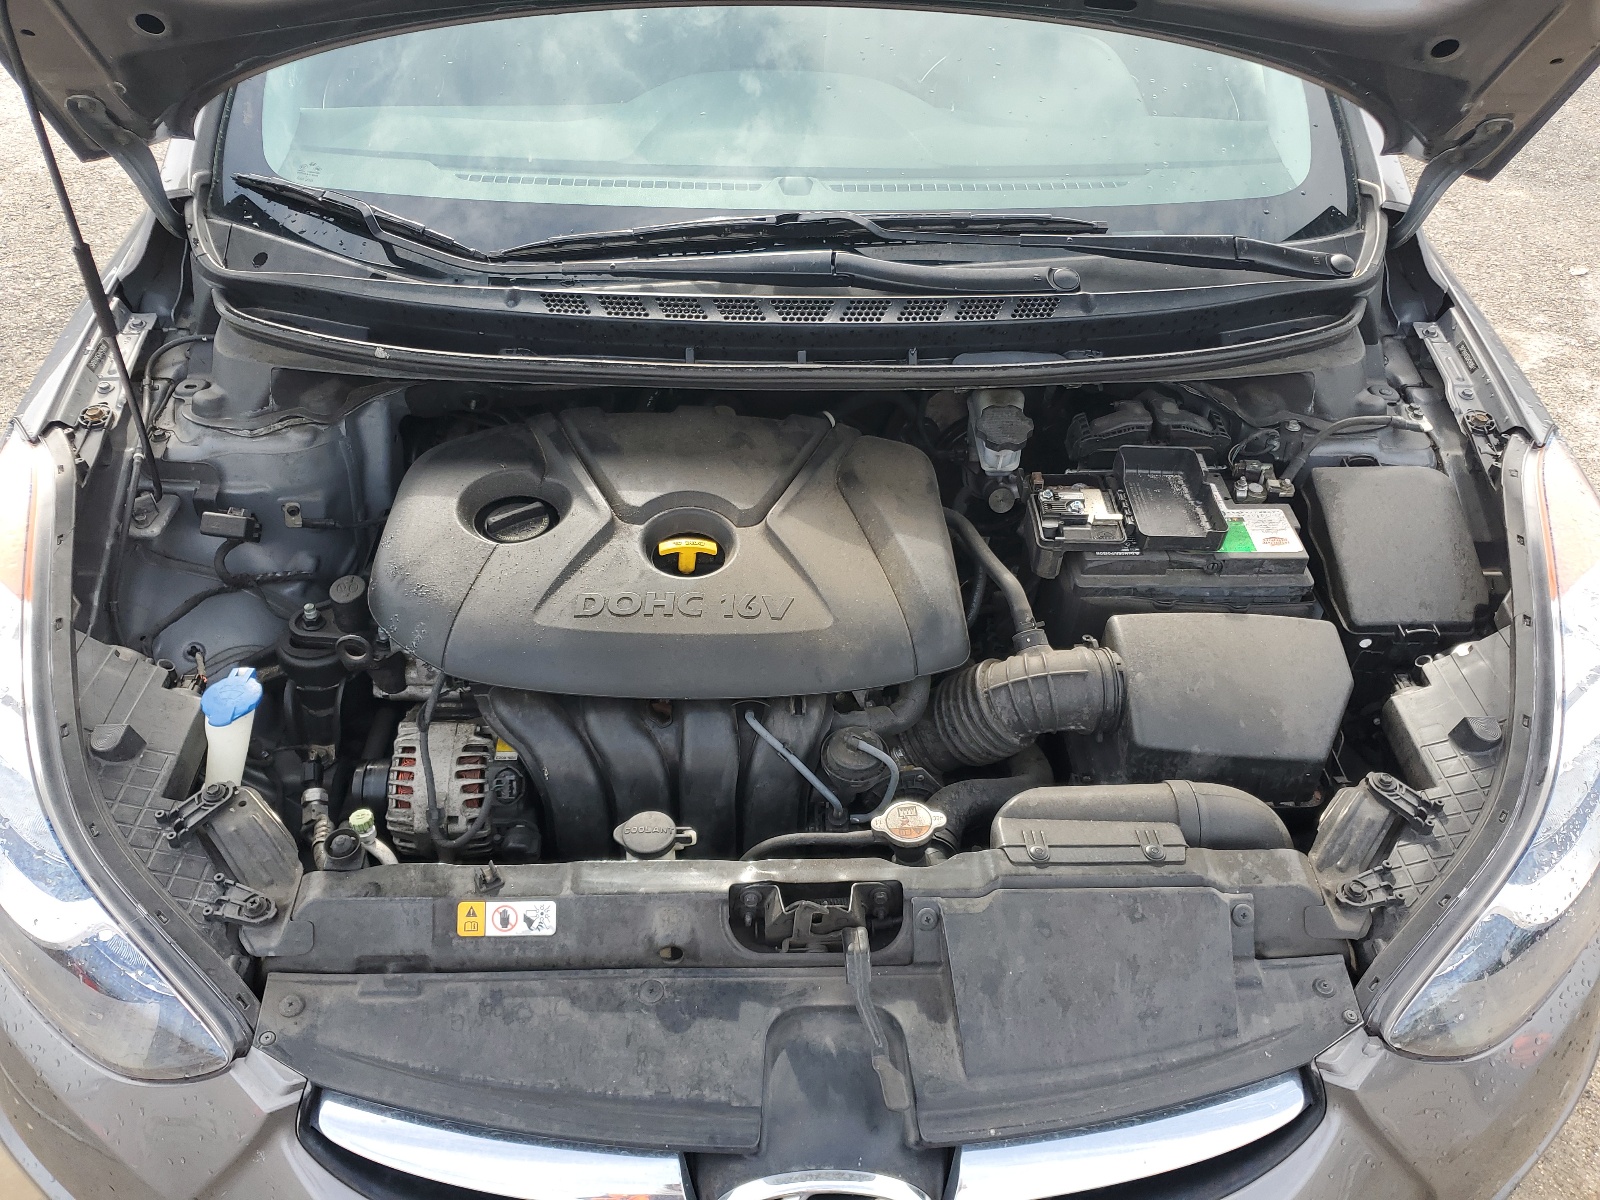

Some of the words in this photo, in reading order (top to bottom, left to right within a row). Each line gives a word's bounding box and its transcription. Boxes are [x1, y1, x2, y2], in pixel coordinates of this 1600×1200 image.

[573, 591, 704, 618] DOHC
[720, 593, 795, 621] 16V
[624, 826, 675, 835] COOLANT
